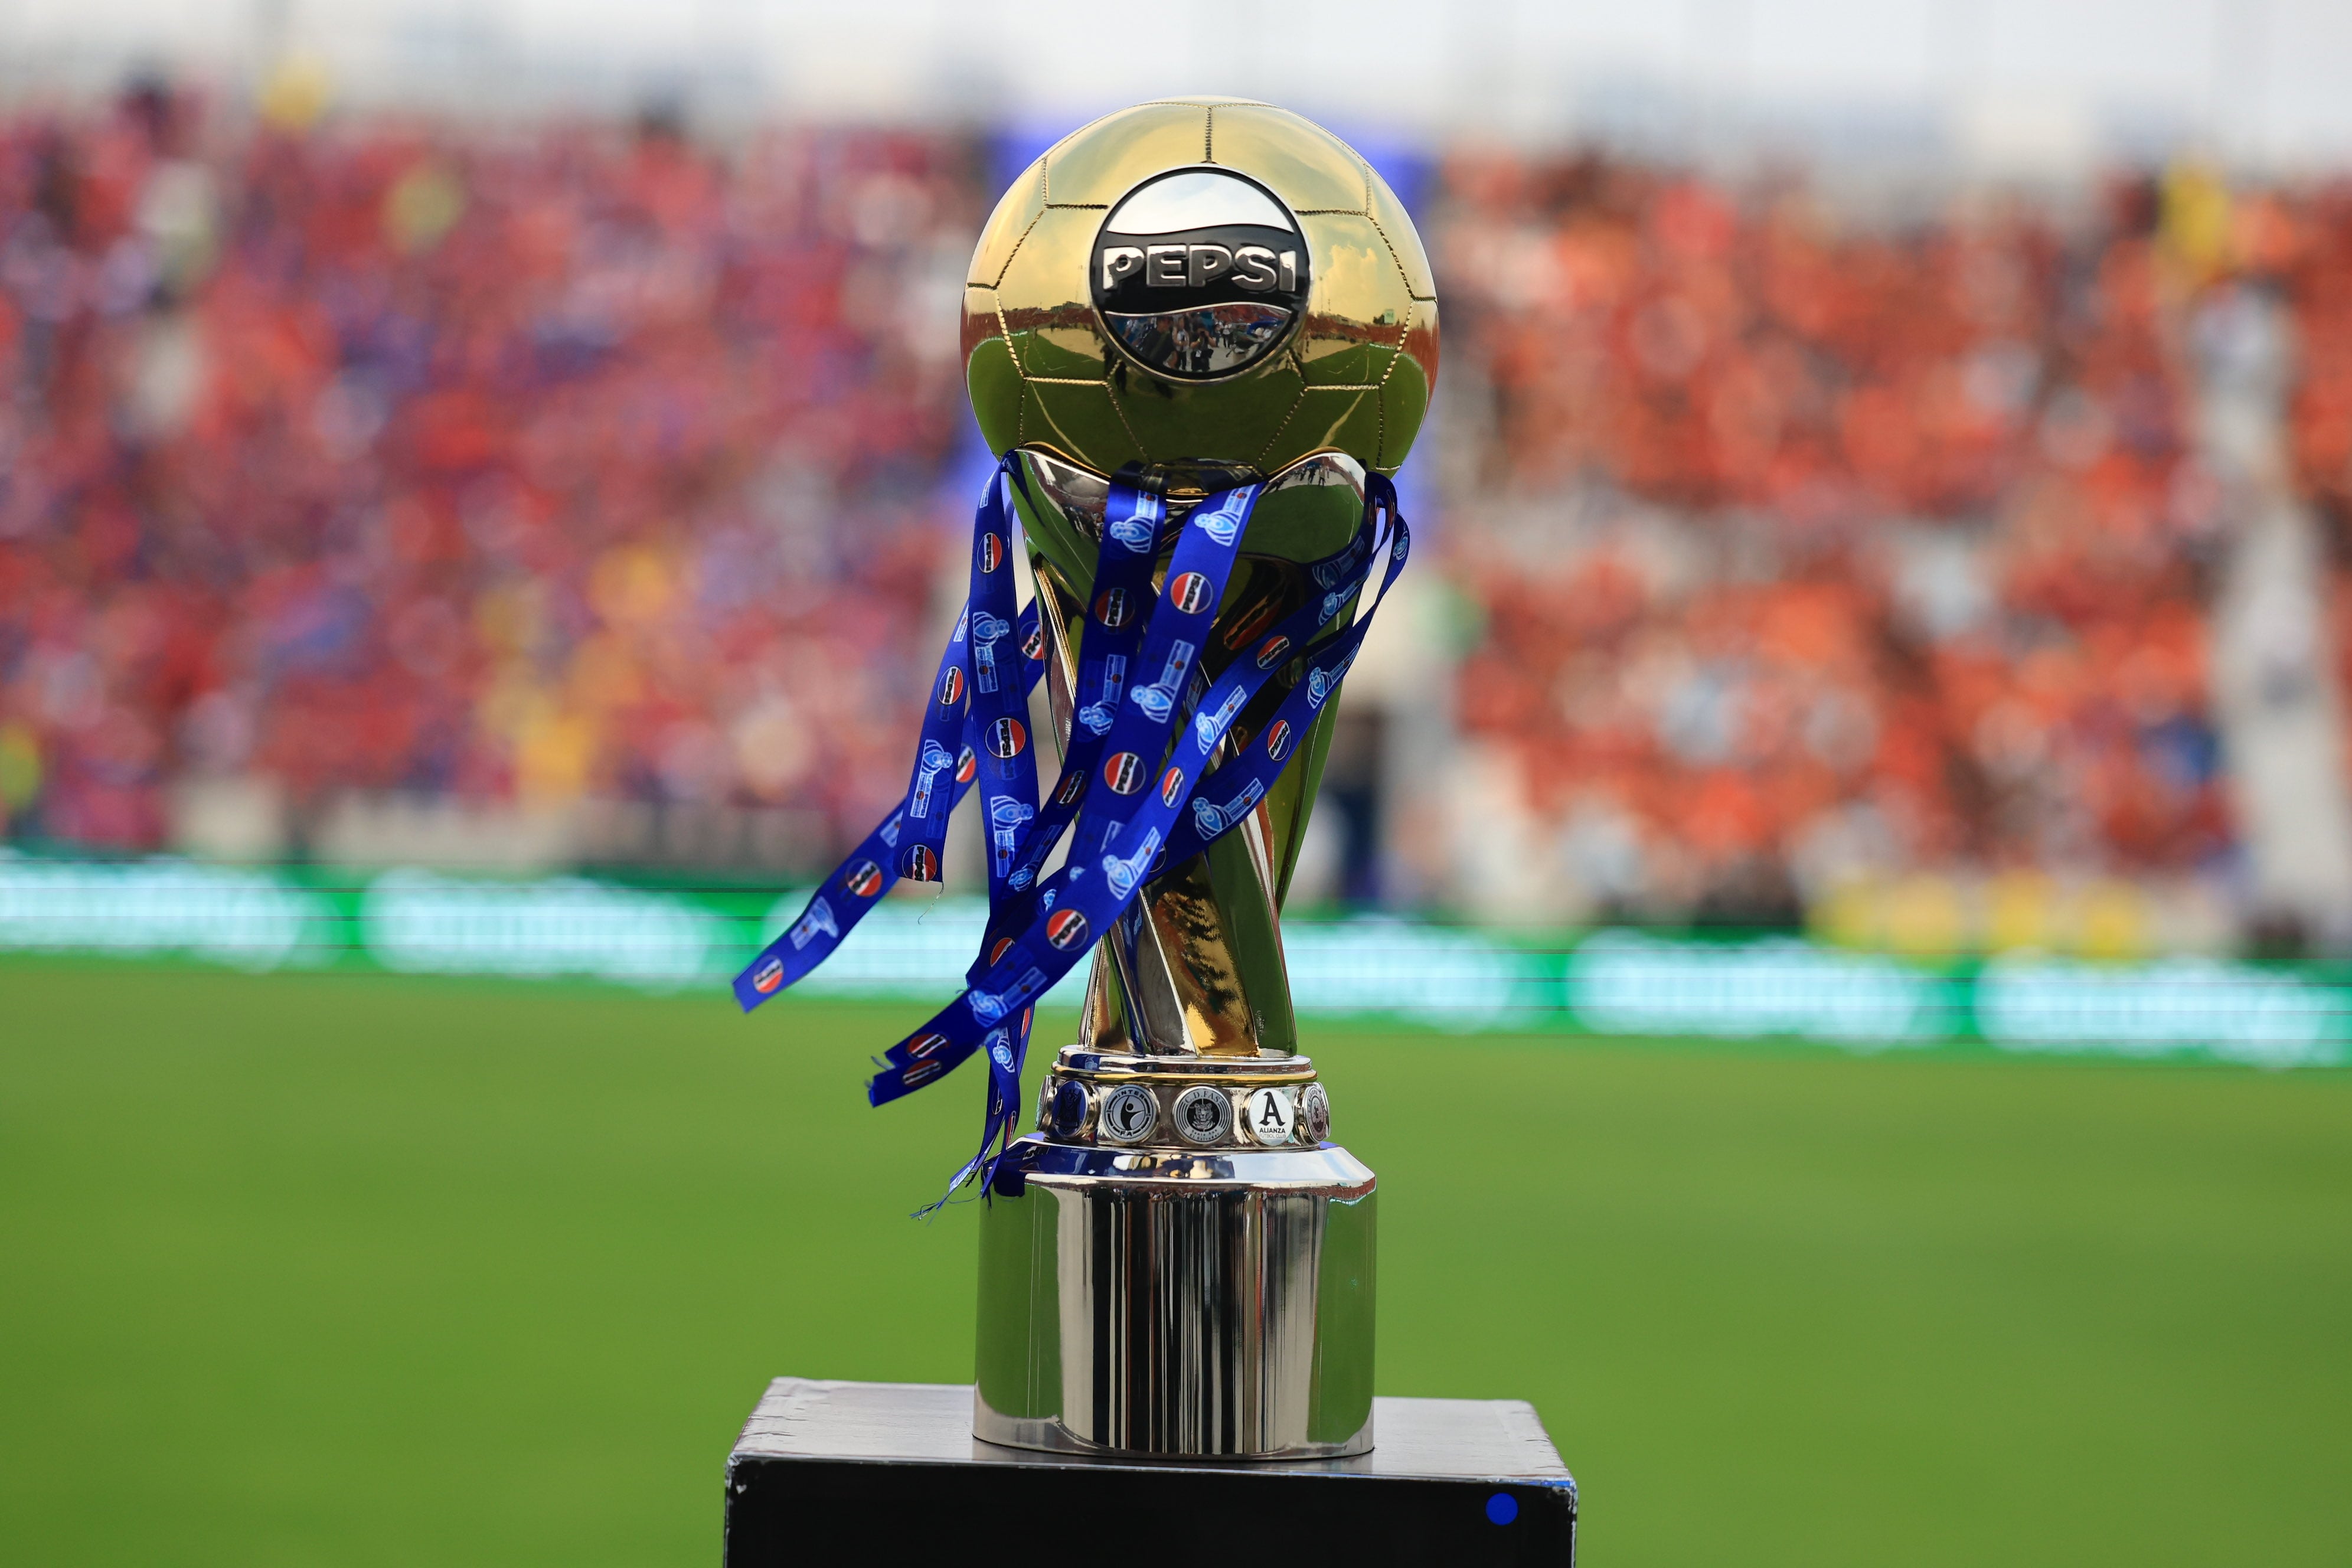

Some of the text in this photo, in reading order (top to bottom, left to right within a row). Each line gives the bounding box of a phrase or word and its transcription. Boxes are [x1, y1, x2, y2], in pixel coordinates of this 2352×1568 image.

[1103, 244, 1296, 292] PEPSI
[1182, 575, 1201, 610] PEPSI
[1259, 639, 1288, 665] PEPSI
[945, 668, 956, 703] PEPSI
[999, 719, 1011, 756] PEPSI
[1270, 724, 1288, 756] PEPSI
[1116, 755, 1134, 790] PEPSI
[1165, 772, 1181, 803] PEPSI
[1053, 916, 1082, 945] PEPSI
[1118, 1090, 1145, 1100] INTER
[1259, 1092, 1286, 1126] A
